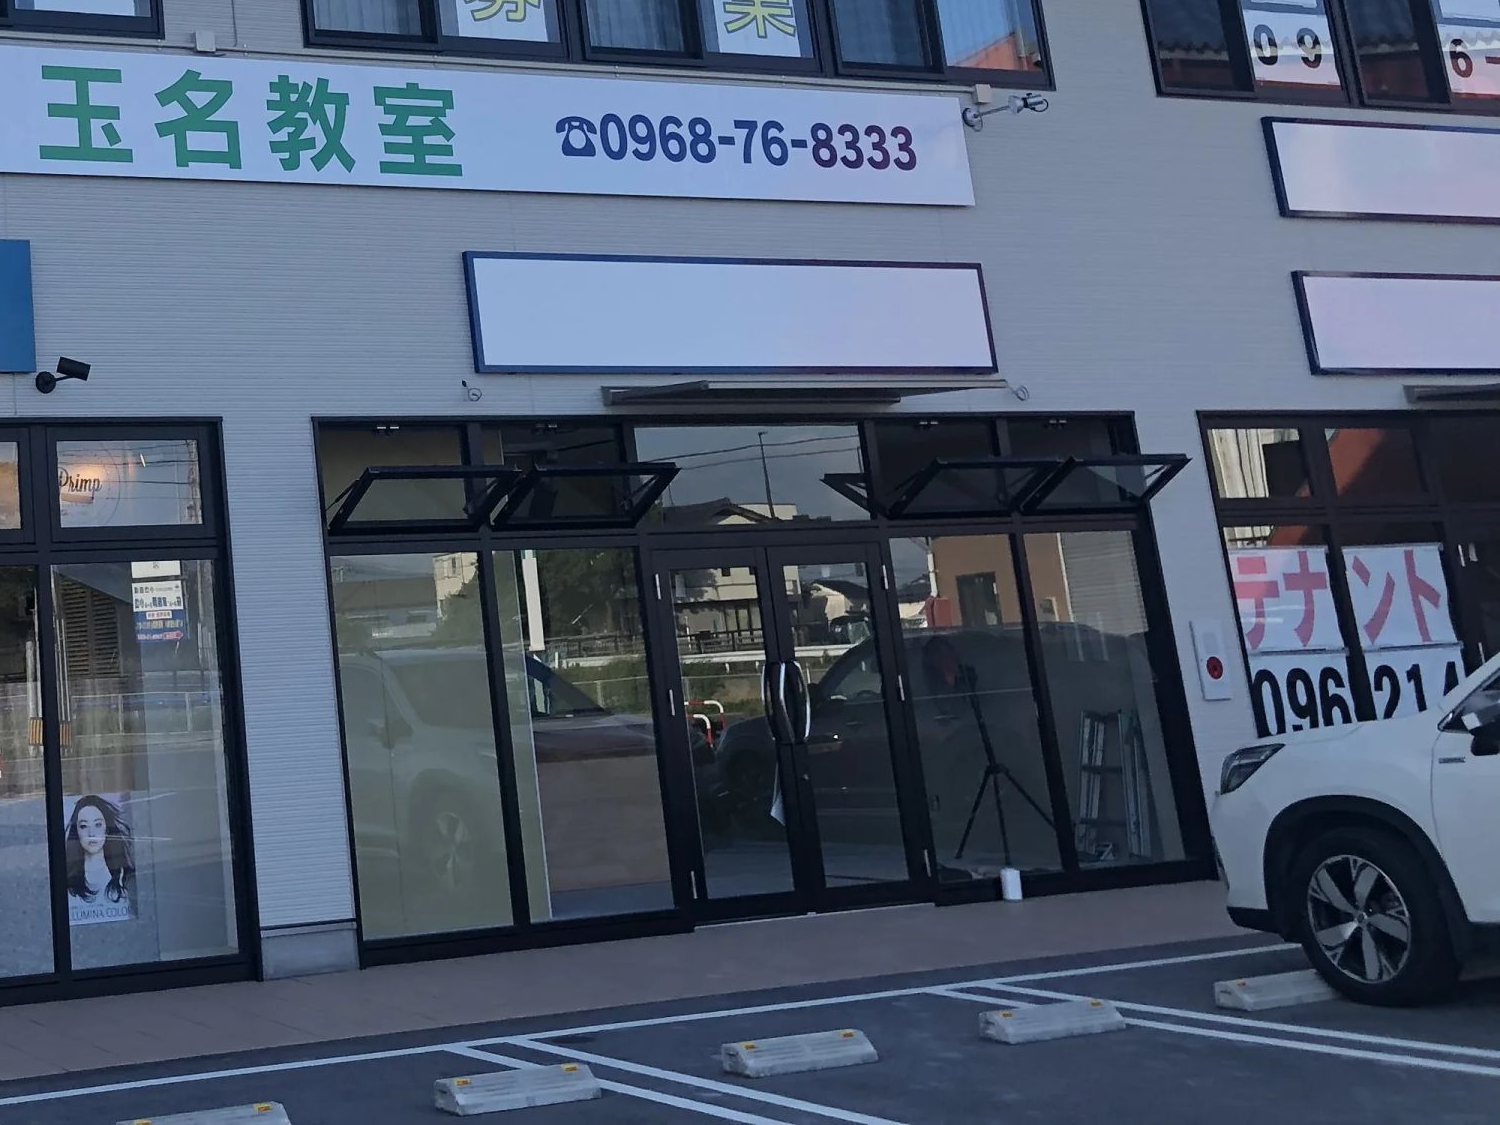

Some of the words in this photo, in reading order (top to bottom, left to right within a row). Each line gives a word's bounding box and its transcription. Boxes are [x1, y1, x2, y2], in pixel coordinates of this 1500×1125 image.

[39, 64, 463, 178] 玉名教室
[598, 113, 918, 172] 0968-76-8333
[1232, 548, 1442, 651] テナント
